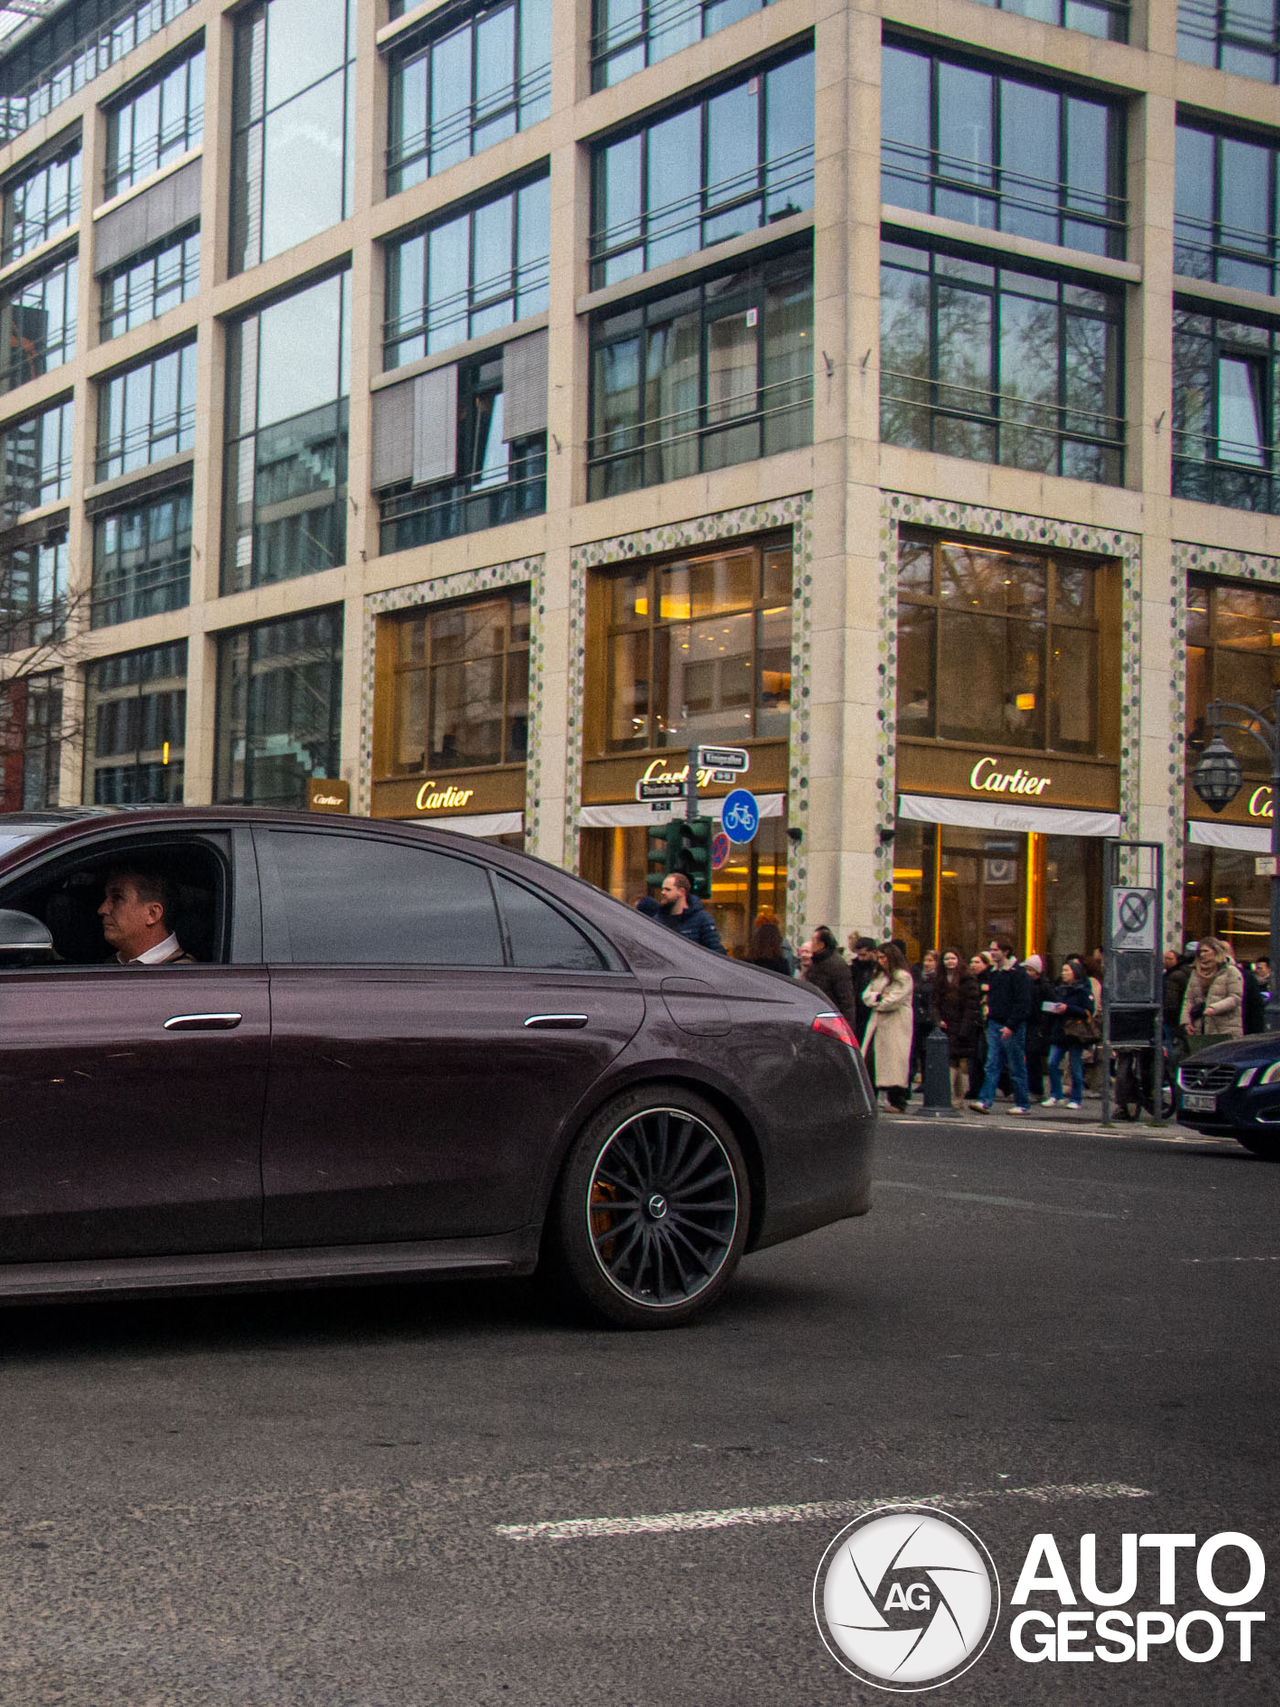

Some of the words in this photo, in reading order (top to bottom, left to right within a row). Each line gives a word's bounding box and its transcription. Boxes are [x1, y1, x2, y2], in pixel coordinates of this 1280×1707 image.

[643, 758, 717, 788] Carter
[970, 757, 1051, 795] Cartier
[313, 794, 344, 805] Cartier
[416, 780, 474, 810] Cartier
[993, 811, 1036, 830] Cartier
